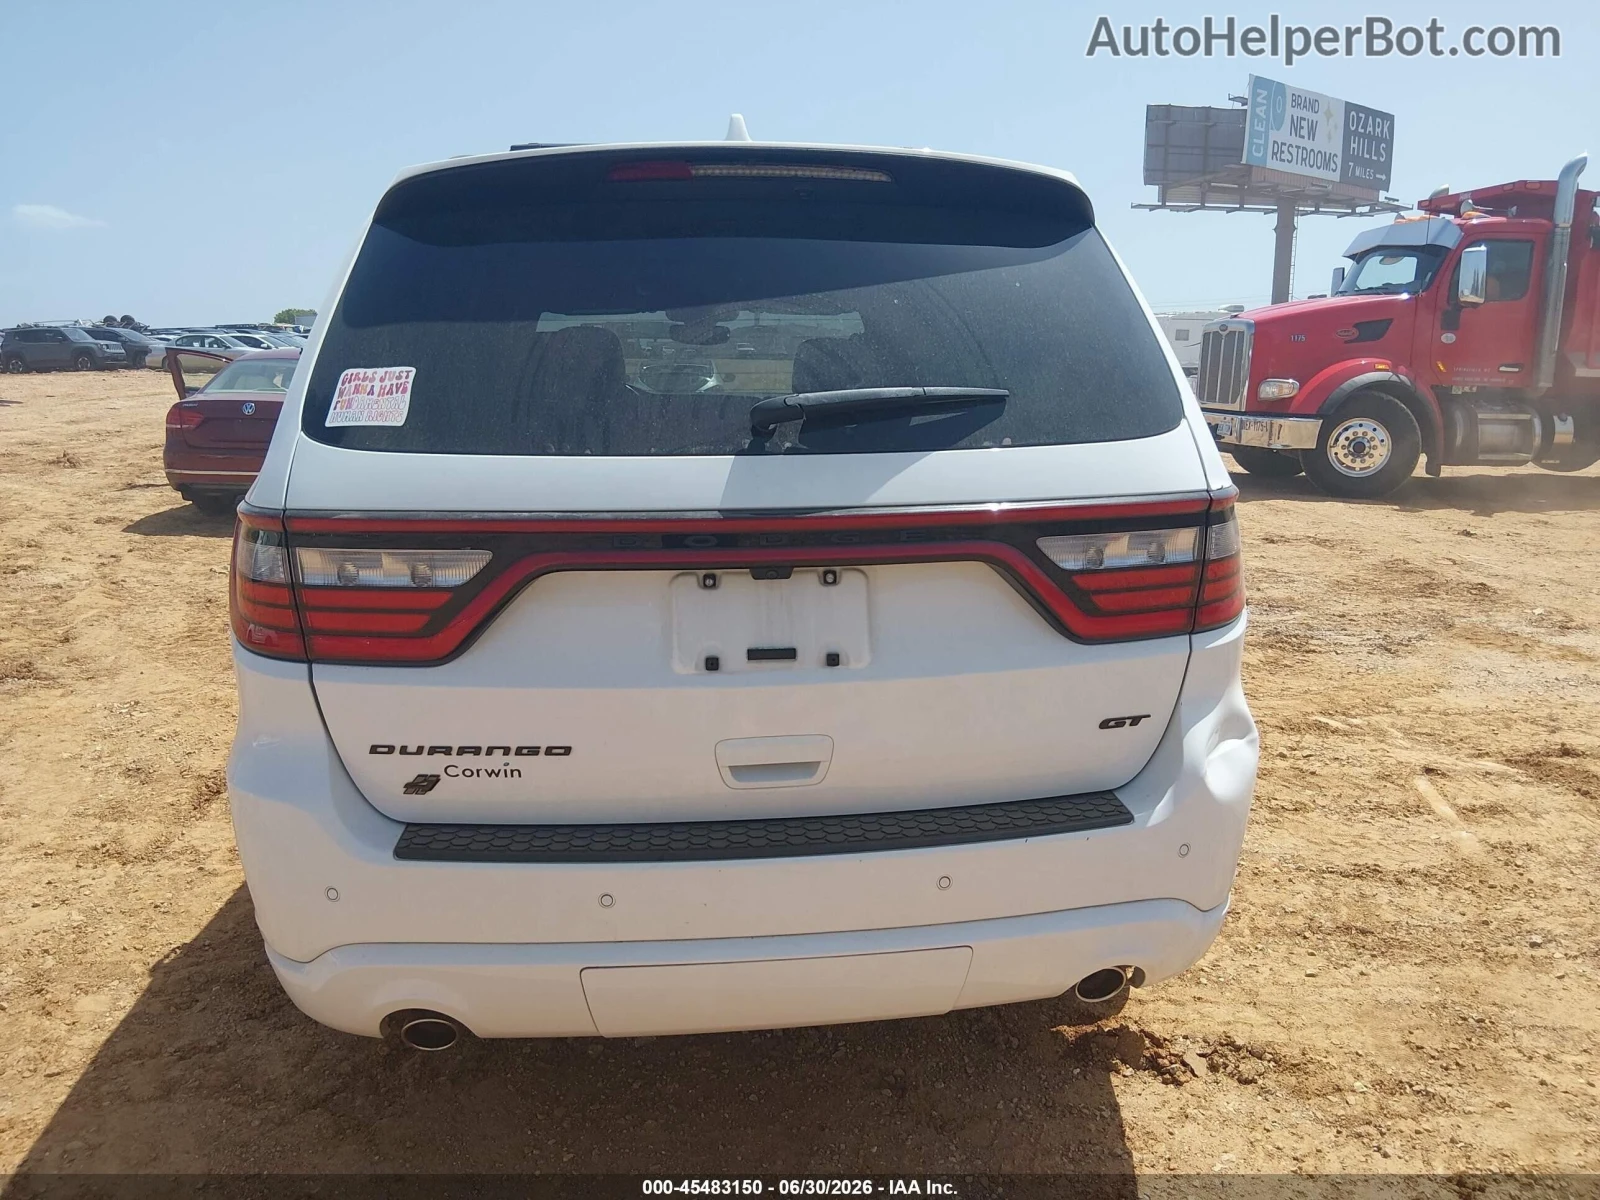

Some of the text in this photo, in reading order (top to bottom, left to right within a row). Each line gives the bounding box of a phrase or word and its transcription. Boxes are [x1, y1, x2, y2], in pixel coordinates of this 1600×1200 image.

[1291, 93, 1320, 114] BRAND
[1252, 89, 1268, 158] CLEAN
[1289, 114, 1318, 142] NEW
[1349, 111, 1390, 139] OZARK
[1271, 140, 1339, 173] RESTROOMS
[1350, 136, 1386, 162] HILLS
[1348, 162, 1374, 180] 7 MILES
[1290, 334, 1306, 343] 1175
[341, 370, 413, 387] GIRLS JUST
[338, 381, 410, 399] WANNA HAVE
[333, 395, 406, 411] FUNDAMENTAL
[329, 410, 404, 423] HUMAN RIGHTS
[612, 529, 925, 548] DODGE
[1098, 714, 1152, 730] GT
[368, 744, 573, 757] DURANGO
[443, 762, 522, 778] Corwin
